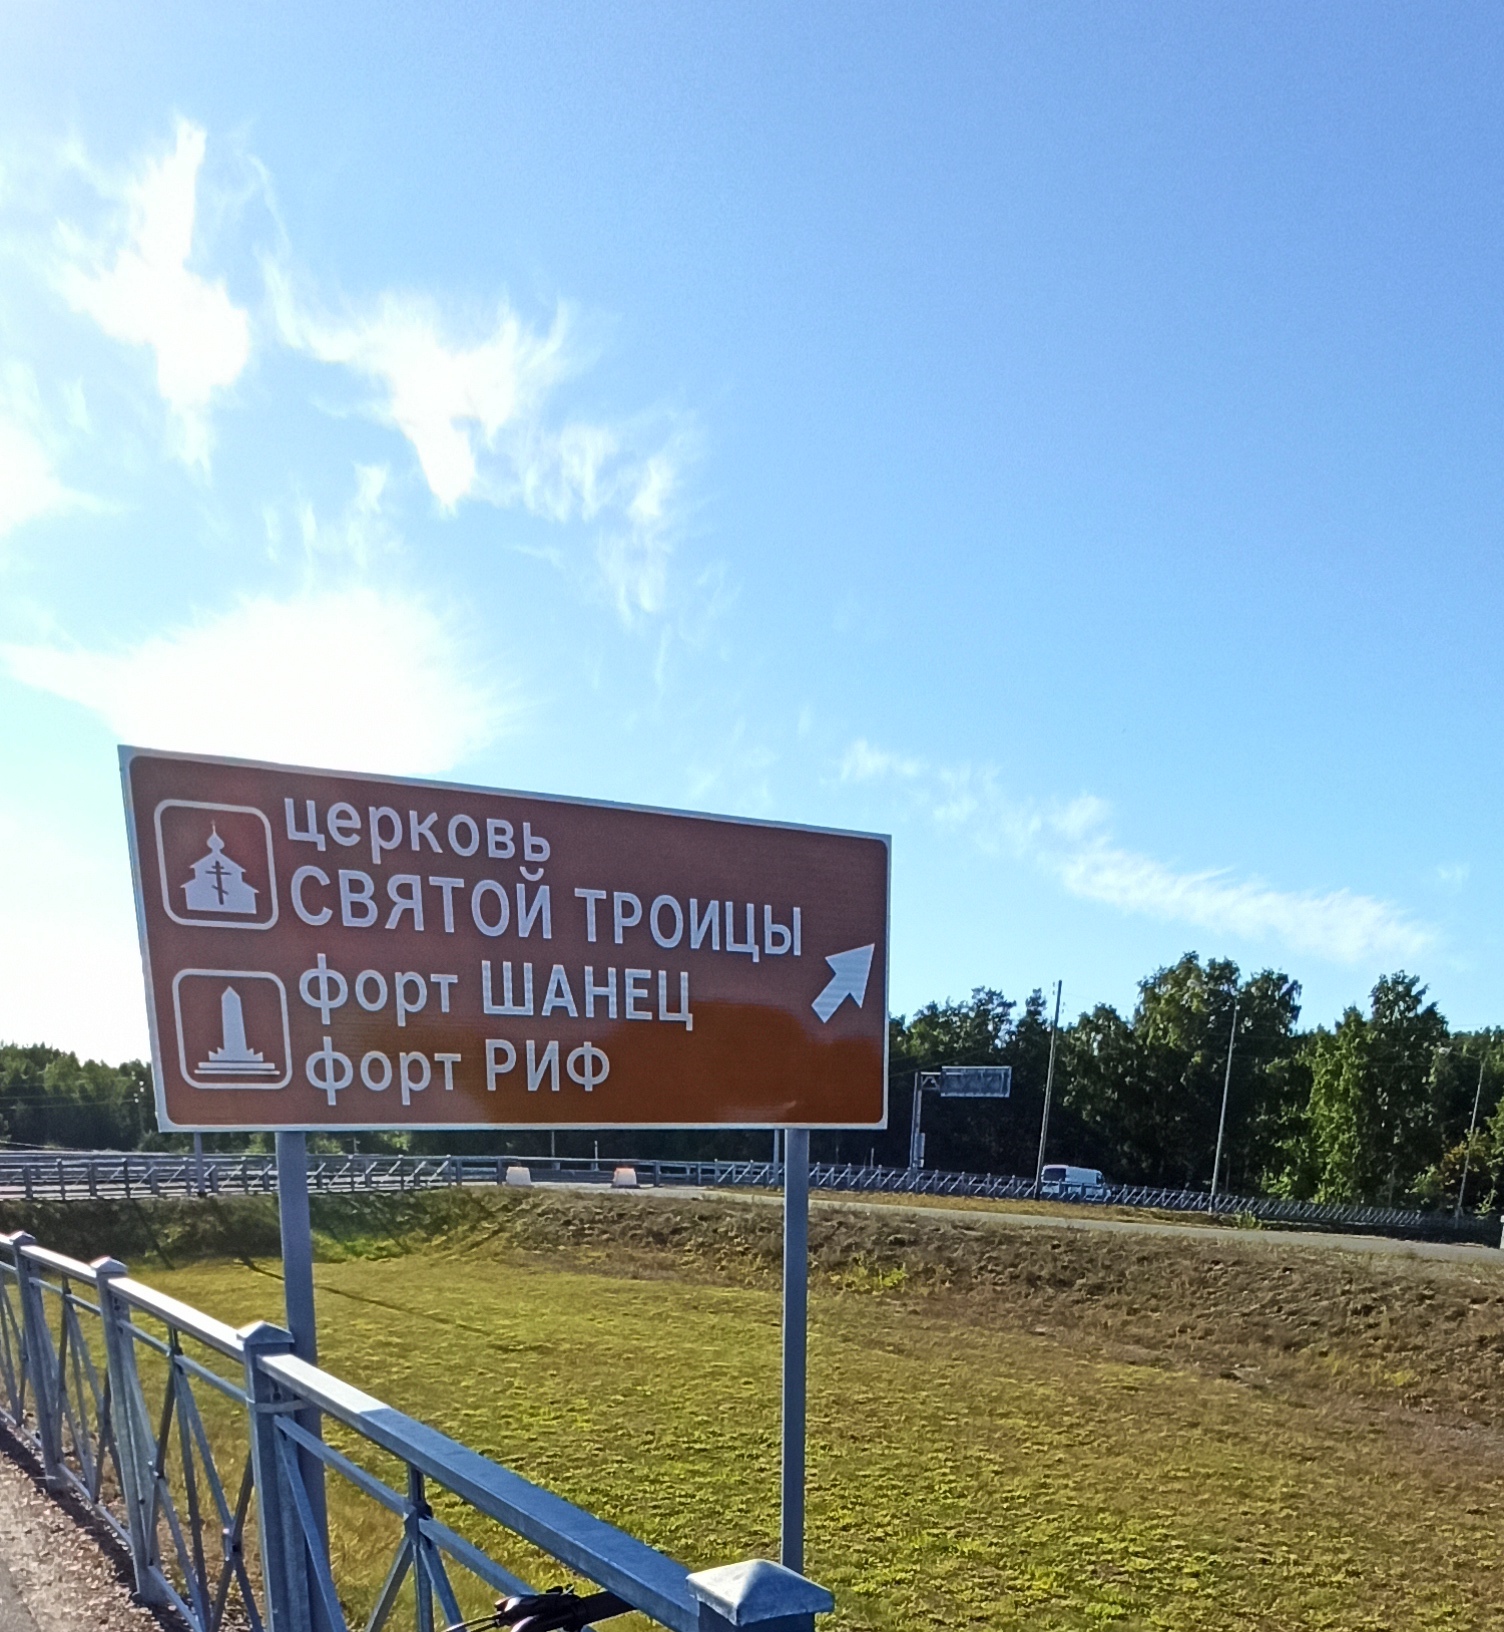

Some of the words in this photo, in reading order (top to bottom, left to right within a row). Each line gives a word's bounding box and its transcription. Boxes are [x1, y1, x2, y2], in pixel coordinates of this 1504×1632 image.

[284, 797, 551, 865] церковь
[290, 864, 553, 940] СВЯТОЙ
[574, 887, 802, 963] ТРОИЦЫ
[299, 953, 459, 1027] форт
[481, 959, 693, 1031] ШАНЕЦ
[306, 1036, 463, 1106] форт
[485, 1038, 610, 1092] РИФ
